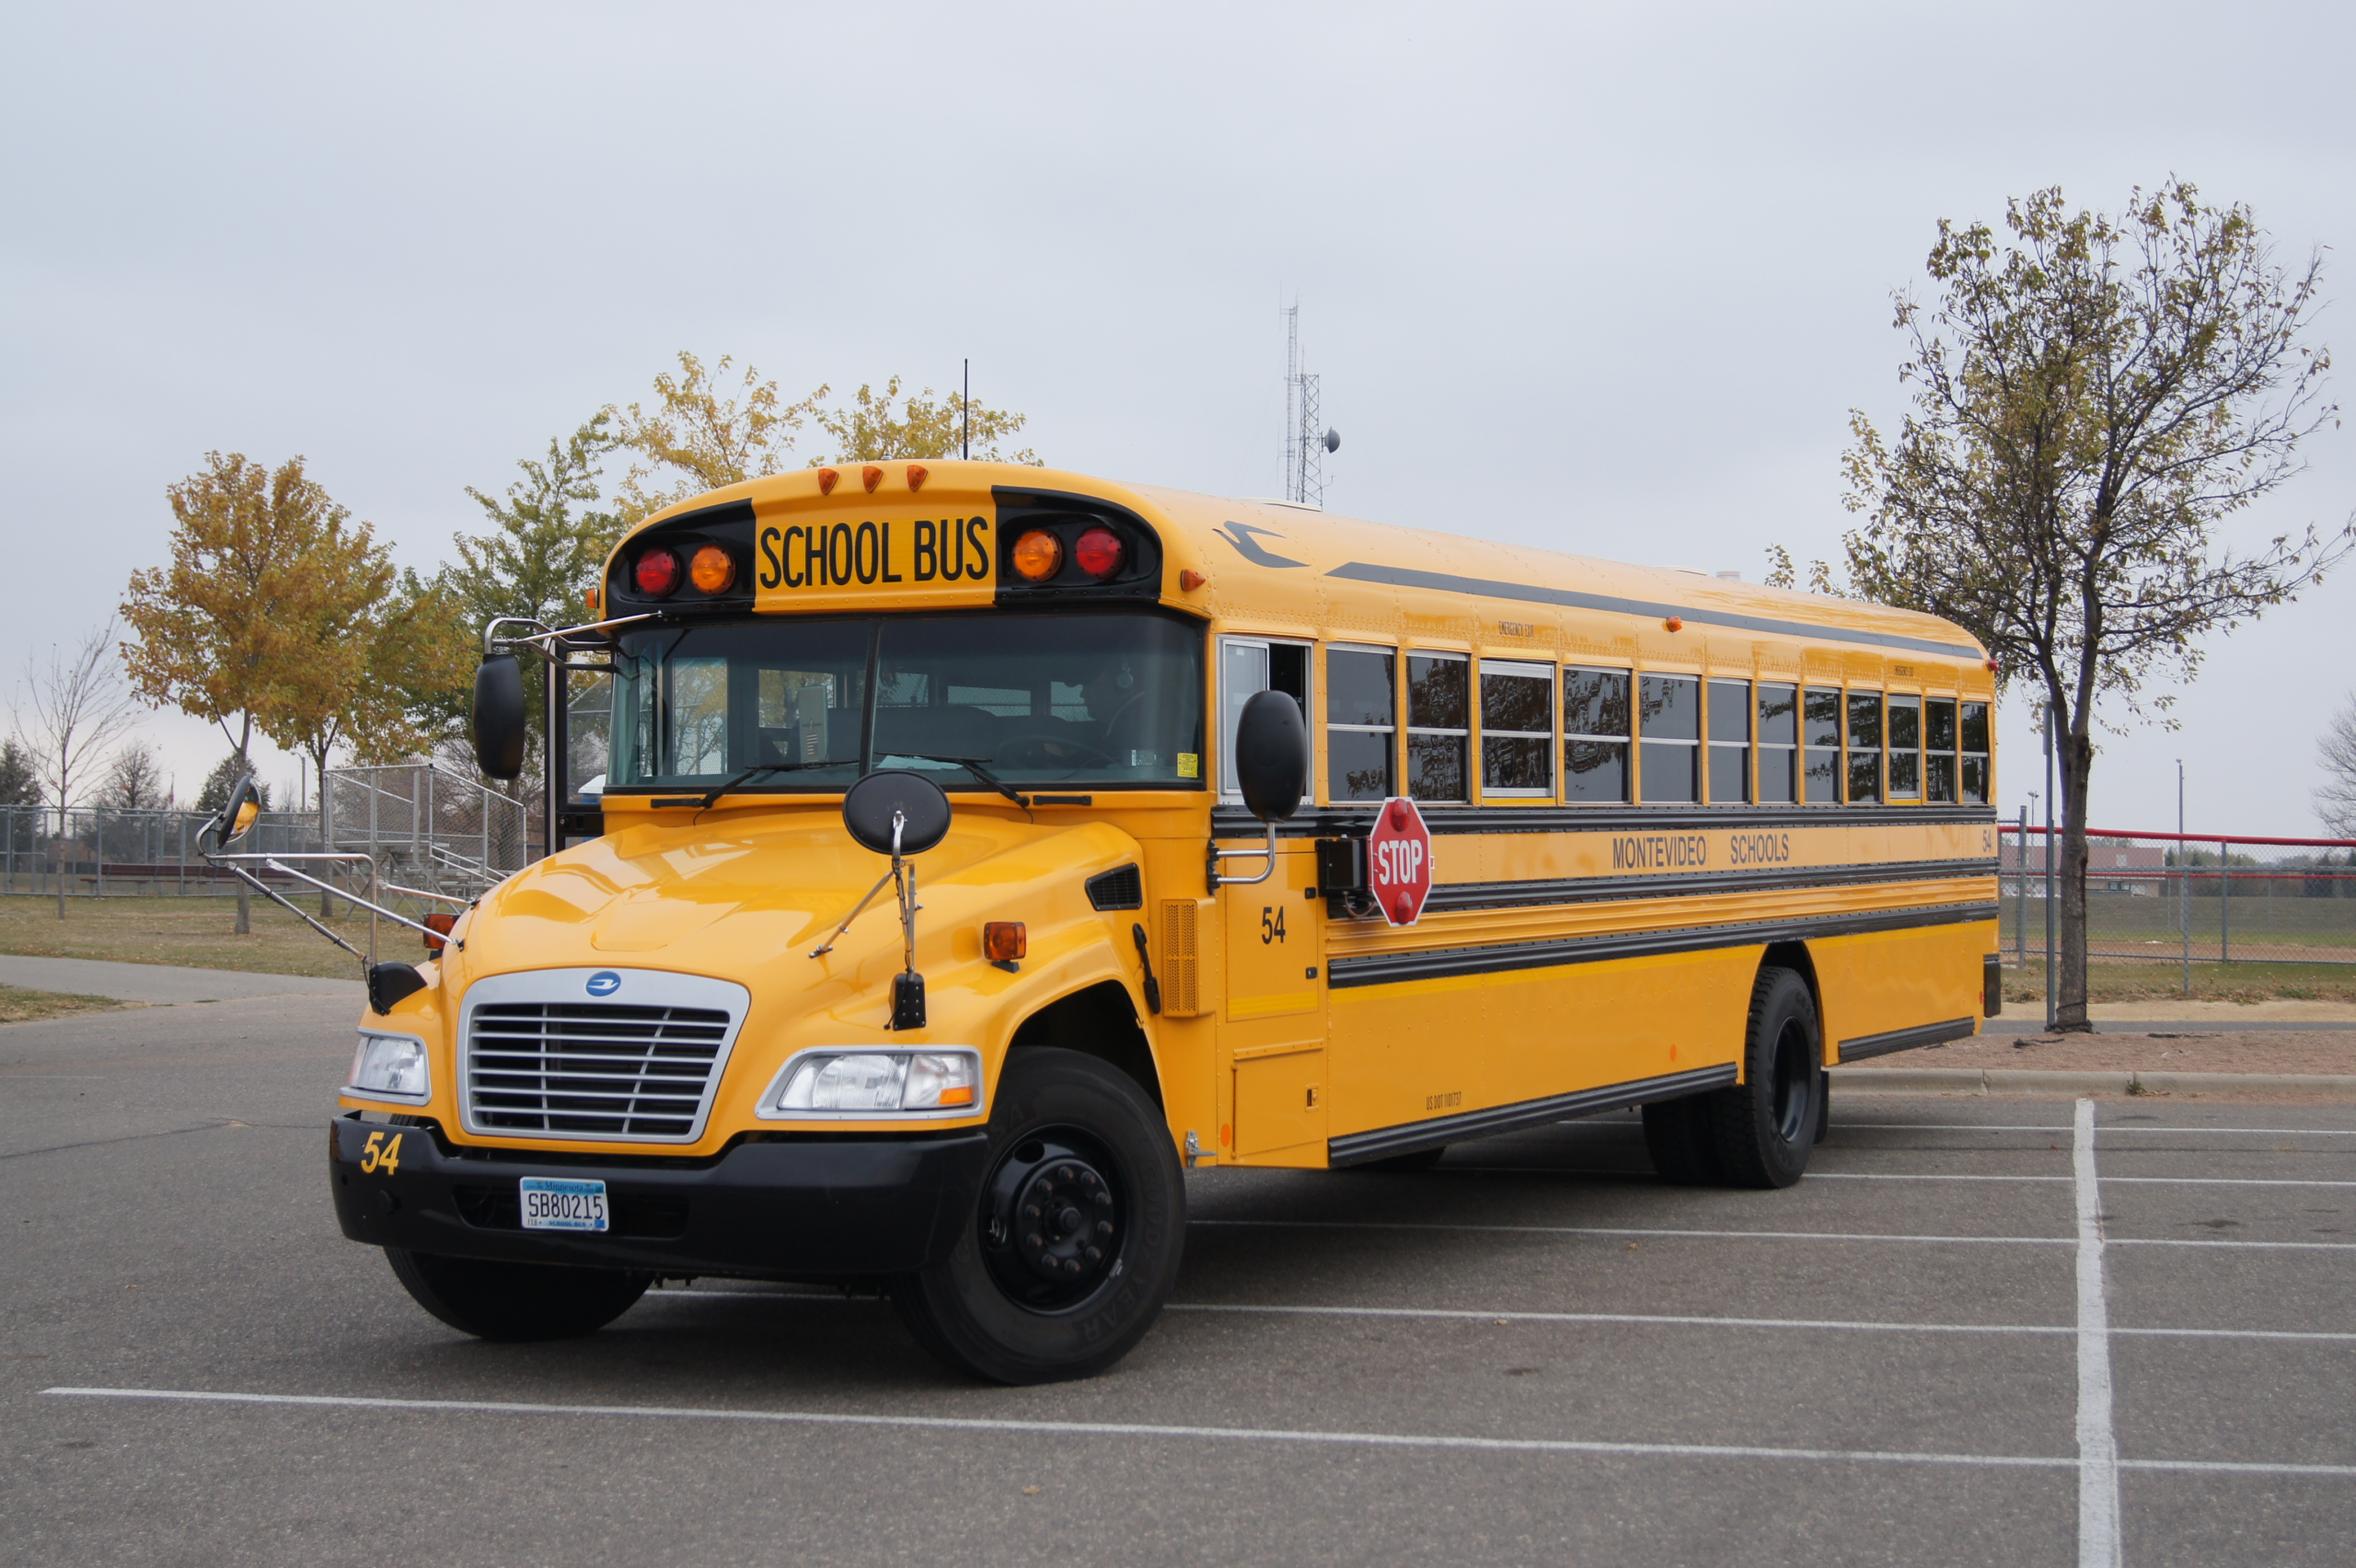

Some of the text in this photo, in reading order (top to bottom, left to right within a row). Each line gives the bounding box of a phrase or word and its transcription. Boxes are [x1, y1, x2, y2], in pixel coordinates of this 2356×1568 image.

[759, 516, 989, 589] SCHOOL BUS
[1612, 833, 1789, 869] MONTEVIDEO SCHOOLS
[1982, 829, 1992, 852] 54
[1378, 839, 1423, 885] STOP
[1261, 905, 1286, 945] 54
[1426, 1096, 1433, 1111] US
[1434, 1094, 1443, 1109] DOT
[361, 1131, 403, 1175] 54
[545, 1182, 583, 1190] Minnesota
[528, 1193, 604, 1220] SB80215
